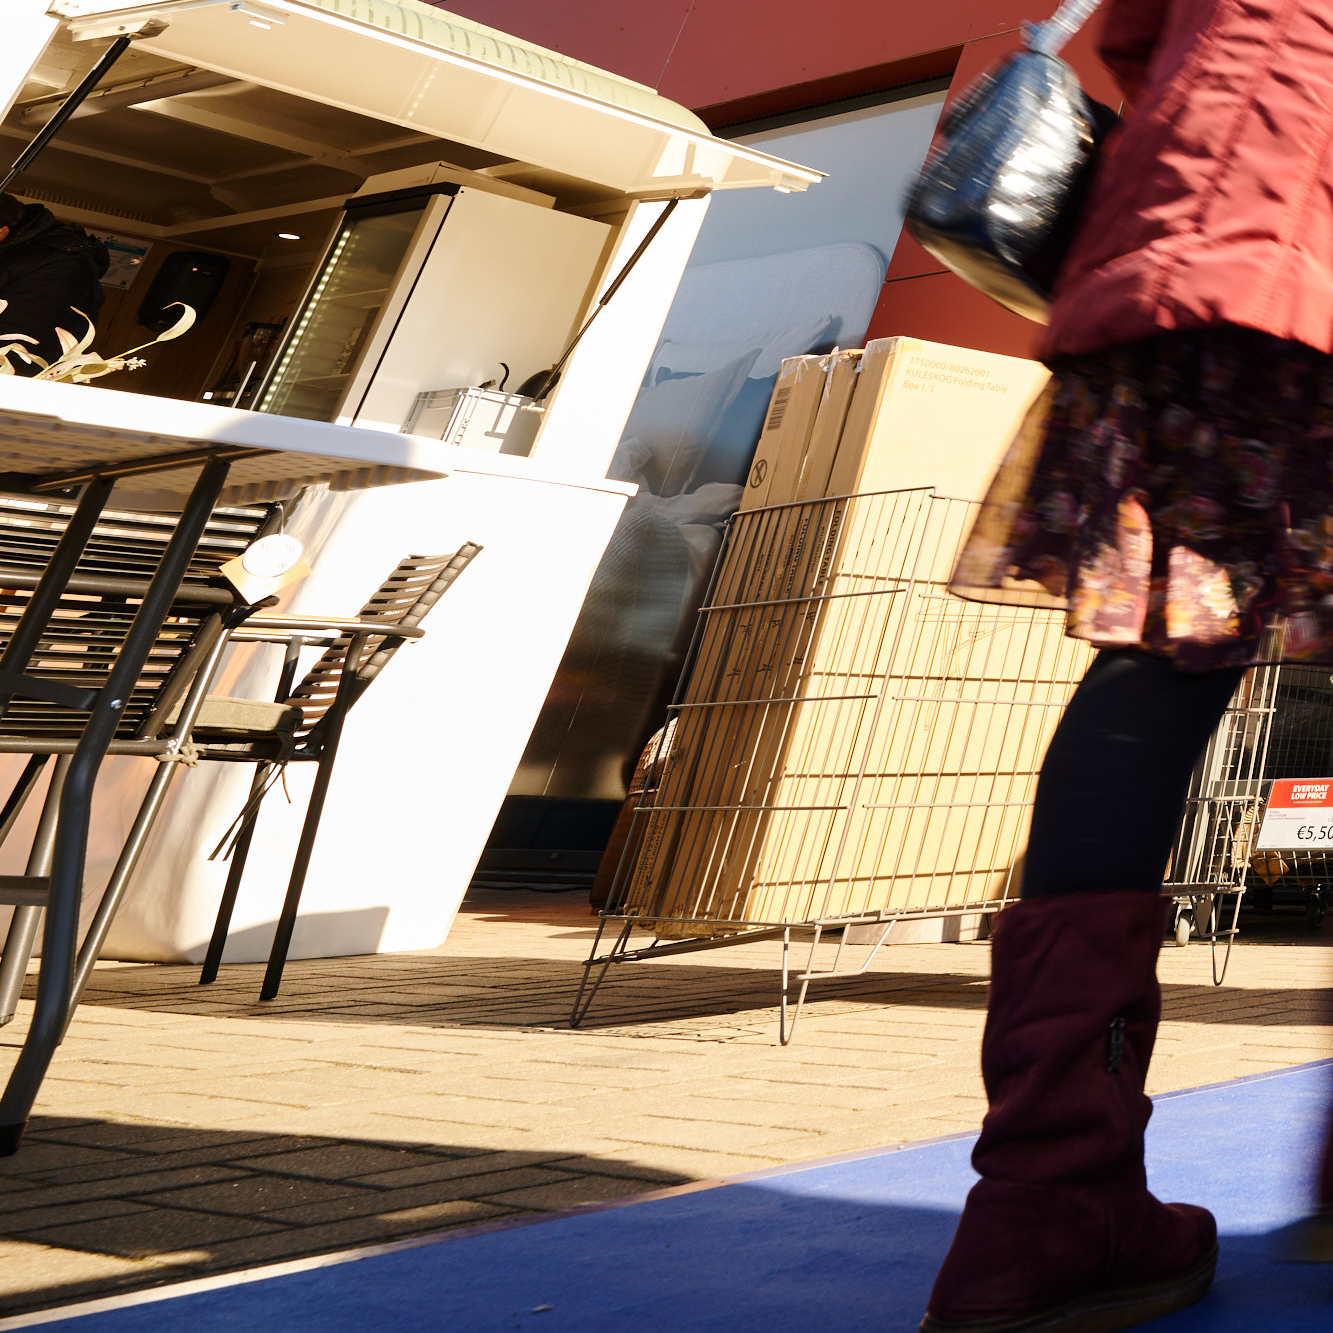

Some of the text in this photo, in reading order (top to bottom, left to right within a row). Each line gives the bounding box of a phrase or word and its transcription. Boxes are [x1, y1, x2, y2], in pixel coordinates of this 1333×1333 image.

[902, 379, 918, 390] Box
[905, 368, 1008, 394] KULESKOG Folding Table
[818, 509, 841, 585] FOLDING TABLE
[1293, 784, 1330, 793] EVERYDAY
[1291, 792, 1327, 800] LOW PRICE
